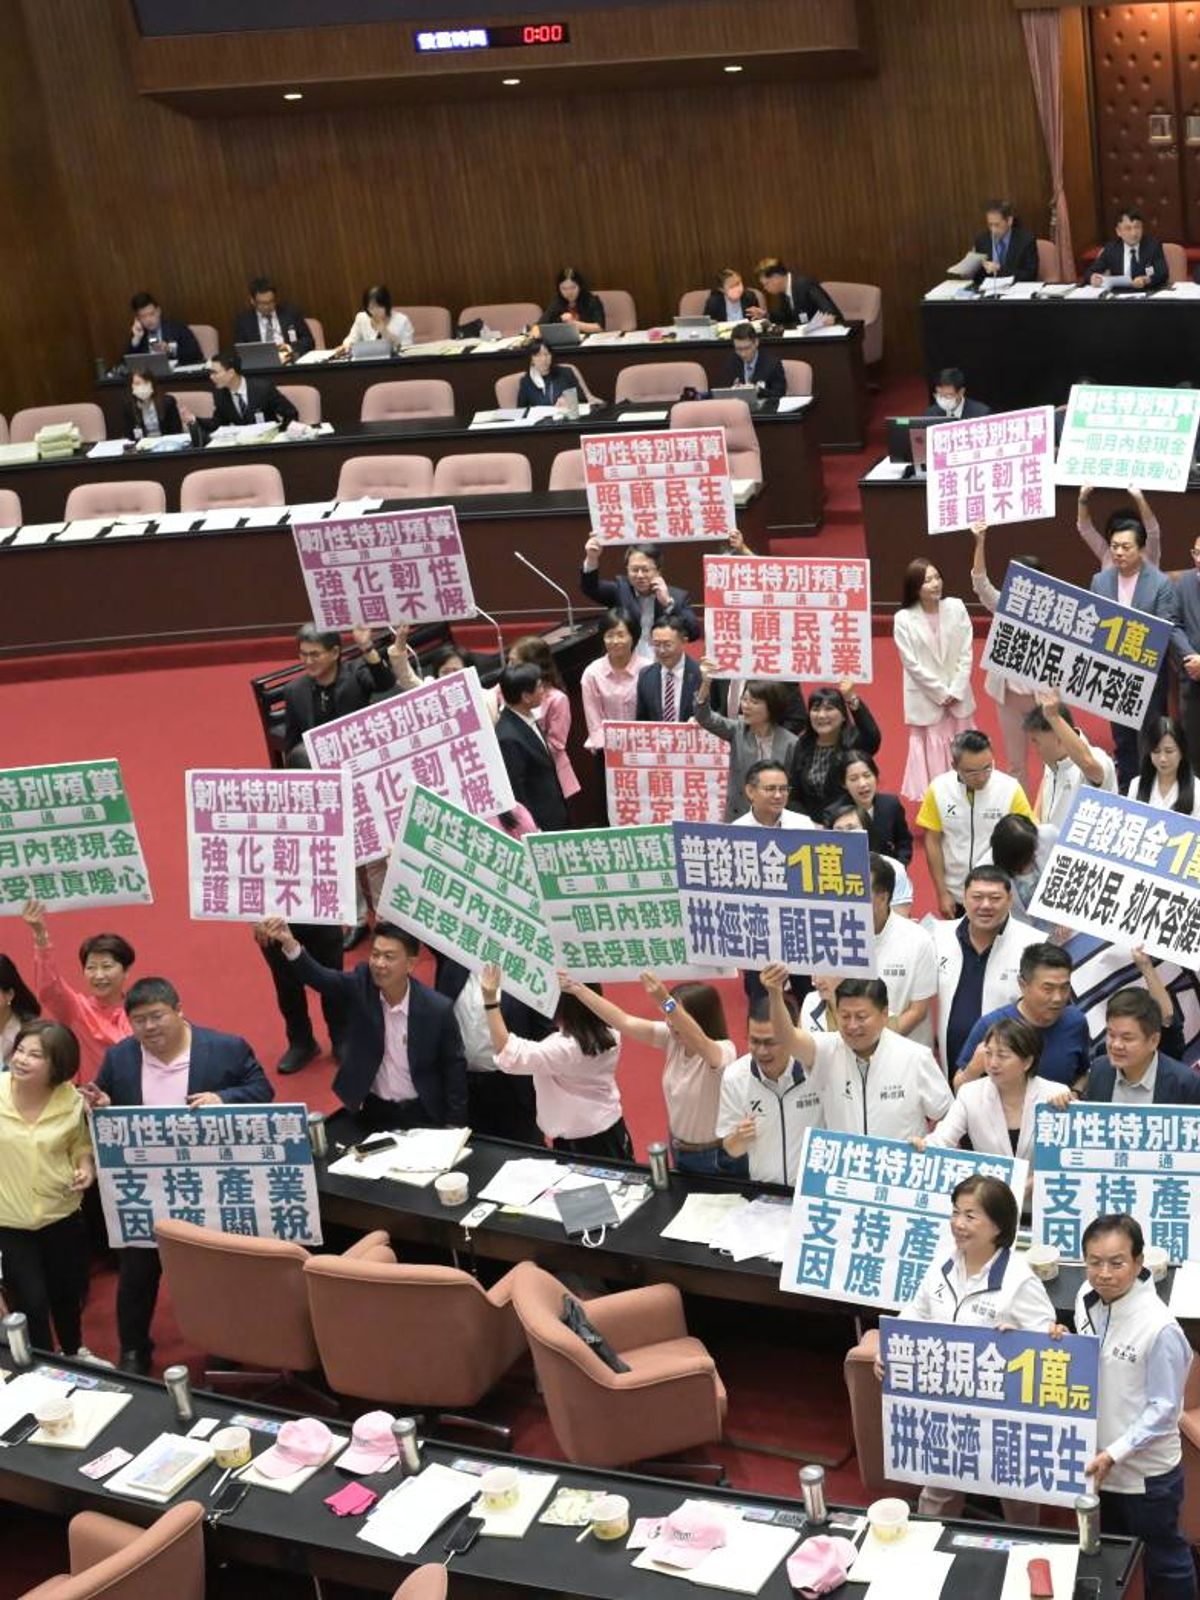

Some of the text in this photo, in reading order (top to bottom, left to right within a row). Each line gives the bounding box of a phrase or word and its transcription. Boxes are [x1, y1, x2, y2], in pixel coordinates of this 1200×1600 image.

[524, 25, 562, 43] 0:00
[585, 435, 722, 466] 韌性特別預算
[1069, 433, 1186, 456] 一個月內發現金
[597, 478, 725, 511] 照顧民生
[939, 457, 1042, 497] 強化韌性
[600, 507, 728, 539] 安定就業
[939, 487, 1042, 527] 護國不懈
[299, 516, 454, 553] 韌性特別預算
[314, 557, 460, 598] 強化韌性
[706, 563, 864, 594] 韌性特別預算
[320, 587, 468, 627] 護國不懈
[713, 611, 861, 642] 照顧民生
[1005, 576, 1158, 668] 普發現金1萬元
[714, 642, 861, 675] 安定就業
[989, 621, 1145, 717] 還錢於民! 刻不容緩!
[314, 681, 470, 766] 韌性特別預算
[193, 779, 341, 813] 韌性特別預算
[201, 836, 338, 876] 強化韌性
[412, 794, 538, 897] 韌性特別
[681, 836, 864, 896] 普發現金1萬元
[202, 875, 340, 919] 護國不懈
[1040, 854, 1124, 926] 還錢於民!
[400, 858, 555, 966] 一個月內發現金
[551, 900, 683, 932] 一個月內發現
[779, 907, 870, 967] 顧民生
[96, 1112, 305, 1148] 韌性特別預算
[112, 1166, 307, 1208] 支持產業
[803, 1200, 941, 1263] 支持產
[796, 1243, 931, 1302] 因應關
[887, 1333, 1090, 1411] 普發現金1萬元
[890, 1403, 1087, 1494] 拼經濟 顧民生
